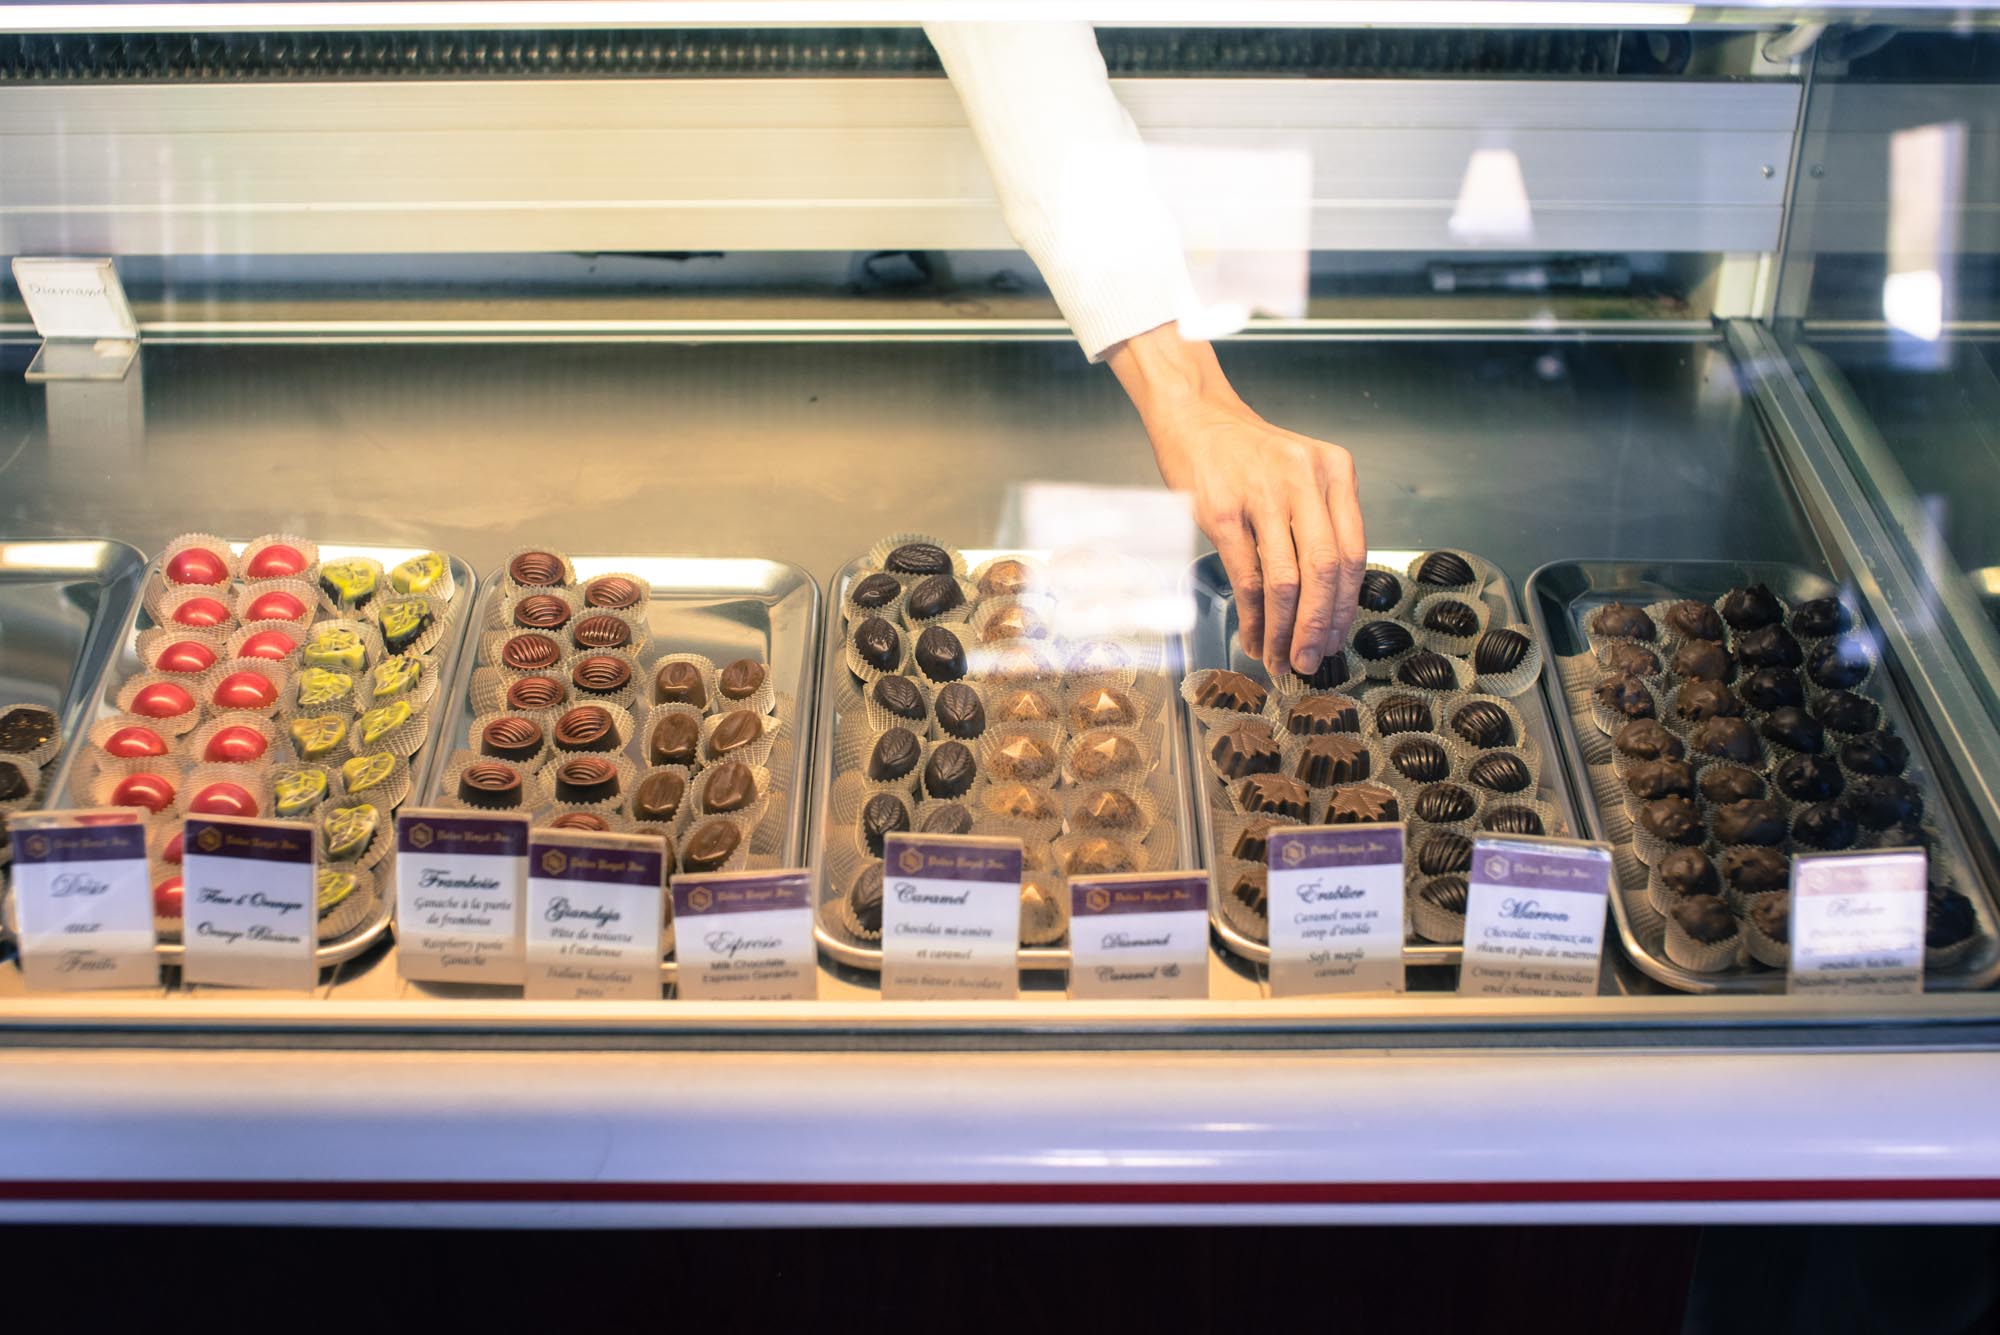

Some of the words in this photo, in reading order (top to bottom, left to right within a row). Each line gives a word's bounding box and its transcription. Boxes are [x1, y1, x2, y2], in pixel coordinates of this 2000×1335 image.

[418, 867, 501, 890] Framboise
[894, 881, 970, 905] Caramel
[414, 896, 458, 911] Ganache
[470, 896, 481, 910] la
[1498, 898, 1570, 922] Marron
[426, 912, 438, 924] de
[1294, 907, 1338, 924] Caramel
[1364, 909, 1379, 919] au
[197, 920, 243, 944] Orange
[1483, 926, 1531, 941] Chocolat
[1313, 963, 1358, 978] caramel
